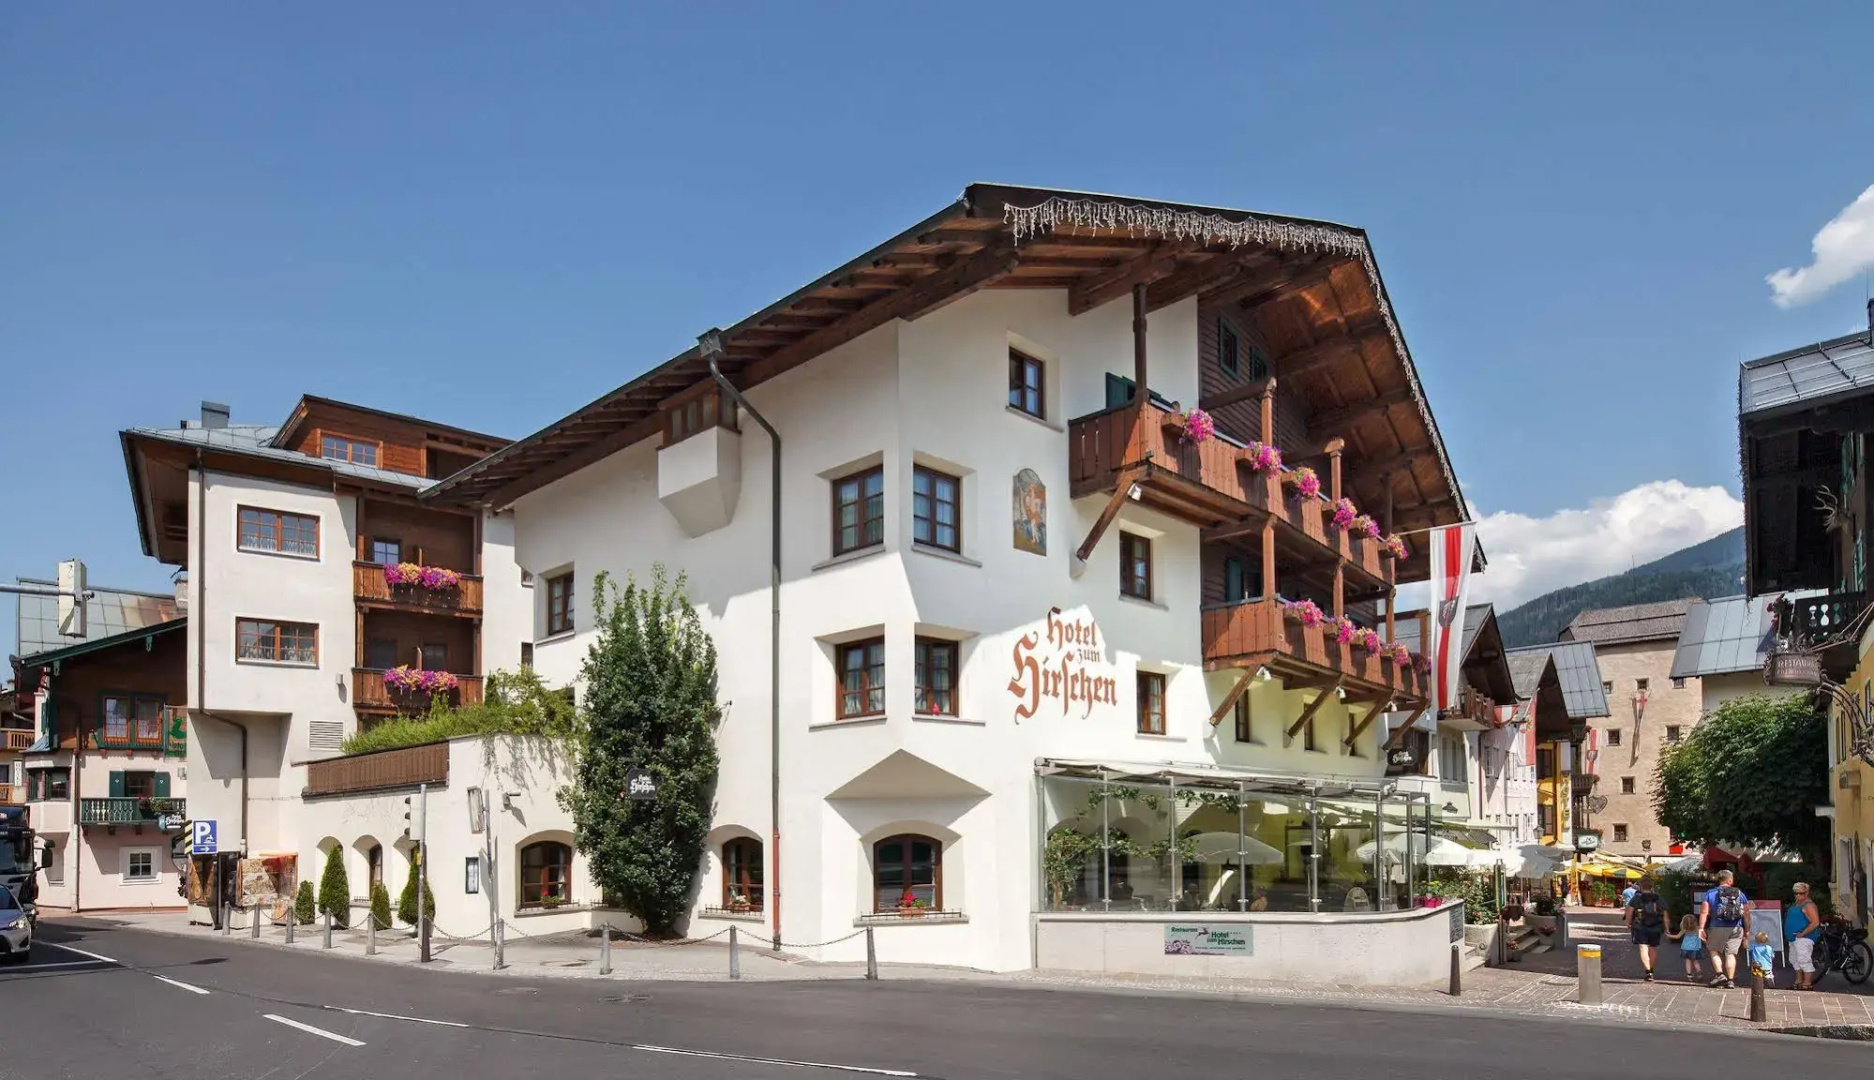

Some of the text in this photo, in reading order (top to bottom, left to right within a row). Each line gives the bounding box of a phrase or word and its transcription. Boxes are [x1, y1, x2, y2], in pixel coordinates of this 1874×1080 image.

[1076, 648, 1101, 664] zum
[1007, 631, 1118, 725] Hirschen
[195, 821, 211, 844] P
